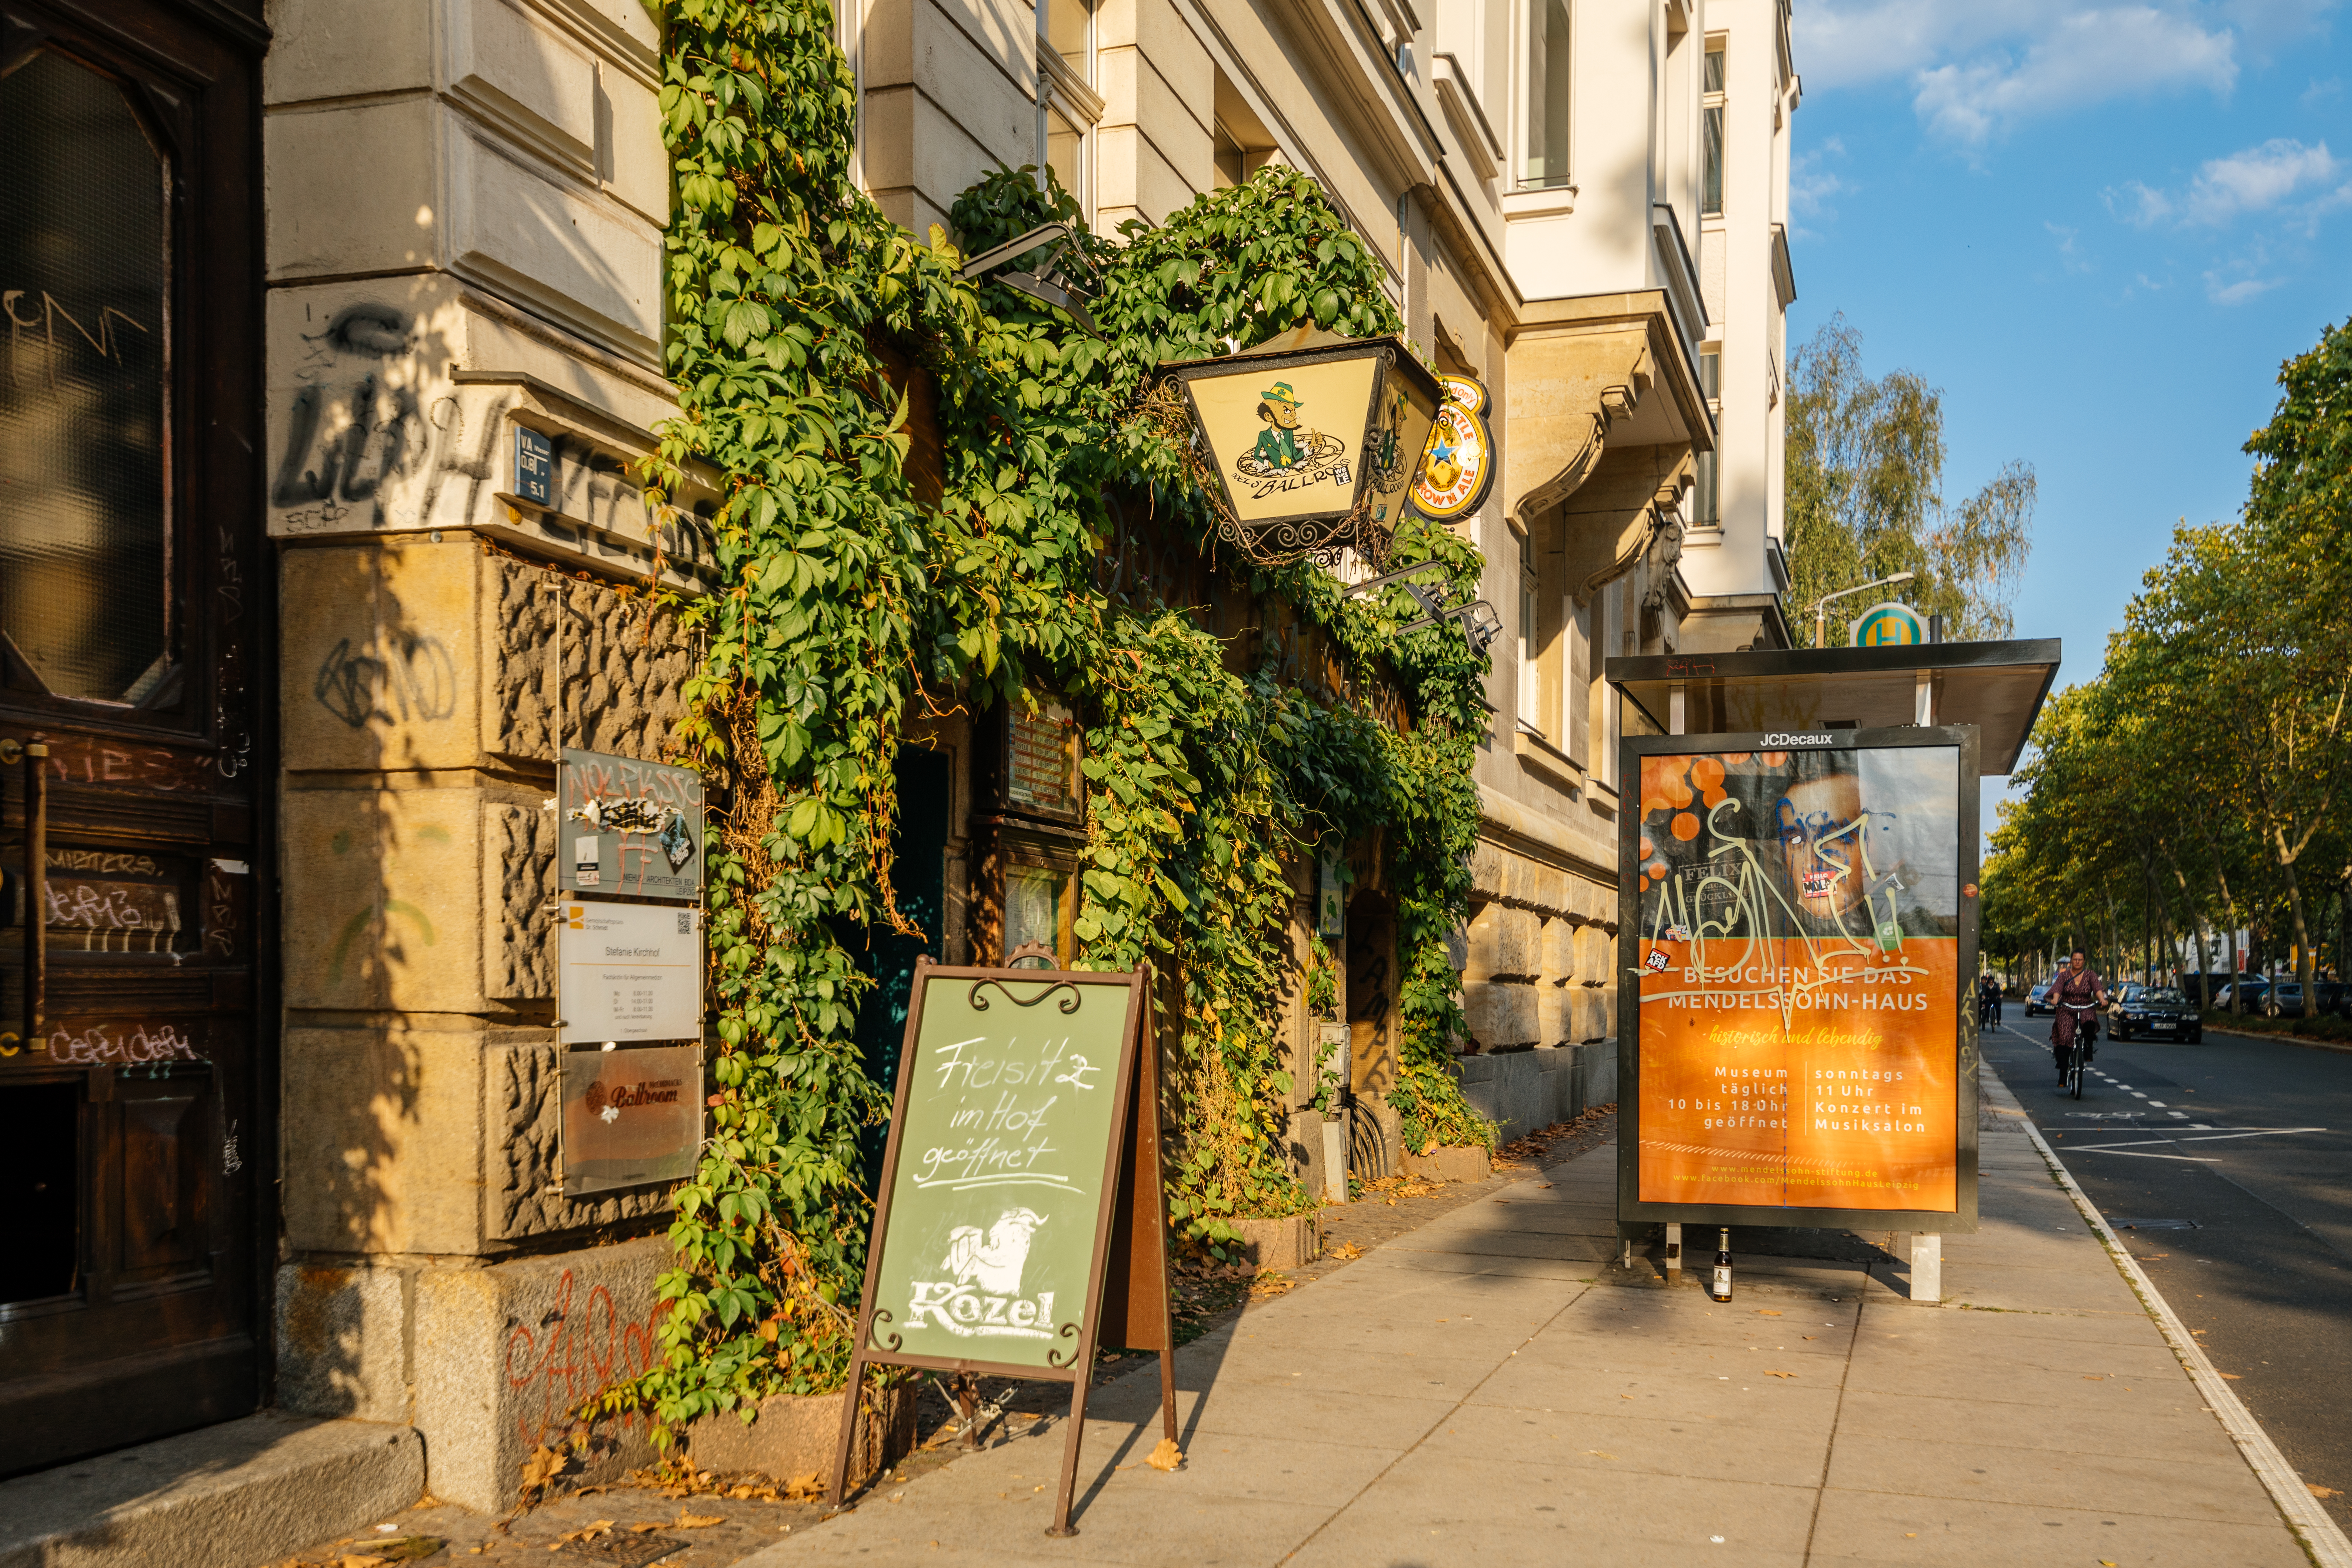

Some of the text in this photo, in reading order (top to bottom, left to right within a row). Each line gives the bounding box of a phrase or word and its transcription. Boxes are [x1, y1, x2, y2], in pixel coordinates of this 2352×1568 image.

[1457, 388, 1476, 404] Only
[1440, 408, 1474, 441] ASTLE
[521, 435, 549, 456] VA Wasser
[1337, 476, 1350, 485] LE
[1418, 469, 1474, 505] ROWN ALE
[1876, 622, 1902, 646] H
[1016, 729, 1025, 738] WOCH
[1760, 733, 1832, 746] JCDecaux
[1017, 743, 1028, 751] RSTAG
[623, 873, 642, 882] NIEHUS
[647, 875, 682, 885] ARCHITEKTEN
[1685, 863, 1742, 881] FELIX
[677, 888, 695, 896] LEIPZIG
[1685, 890, 1747, 903] GLÜCKLIH
[606, 946, 660, 957] Stefanie Kirchhof
[1650, 951, 1667, 964] FCK
[1647, 958, 1664, 969] AFD
[1684, 966, 1911, 984] BESUCHEN SIE DAS
[1668, 993, 1928, 1011] MENDELSSOHN-HAUS
[1709, 1024, 1884, 1051] historisch und lebendig
[935, 1036, 1101, 1091] Freisitz
[1715, 1066, 1788, 1078] Museum
[1815, 1068, 1903, 1082] sonntags
[611, 1082, 678, 1108] Ballroom
[1721, 1082, 1788, 1097] täglich
[1816, 1085, 1874, 1096] 11 Uhr
[1669, 1098, 1788, 1112] 10 bis 18 Uhr
[1815, 1102, 1922, 1115] Konzert im
[950, 1091, 1057, 1141] im Hof
[1704, 1116, 1788, 1131] geöffnet
[1815, 1119, 1925, 1132] Musiksalon
[913, 1137, 1056, 1182] geöffnet
[1712, 1165, 1878, 1178] www.mendelssohn-stiftung.de
[1674, 1173, 1919, 1190] www.facebook.com/MendelssohnHausLeipzig
[903, 1280, 1055, 1337] Kozel
